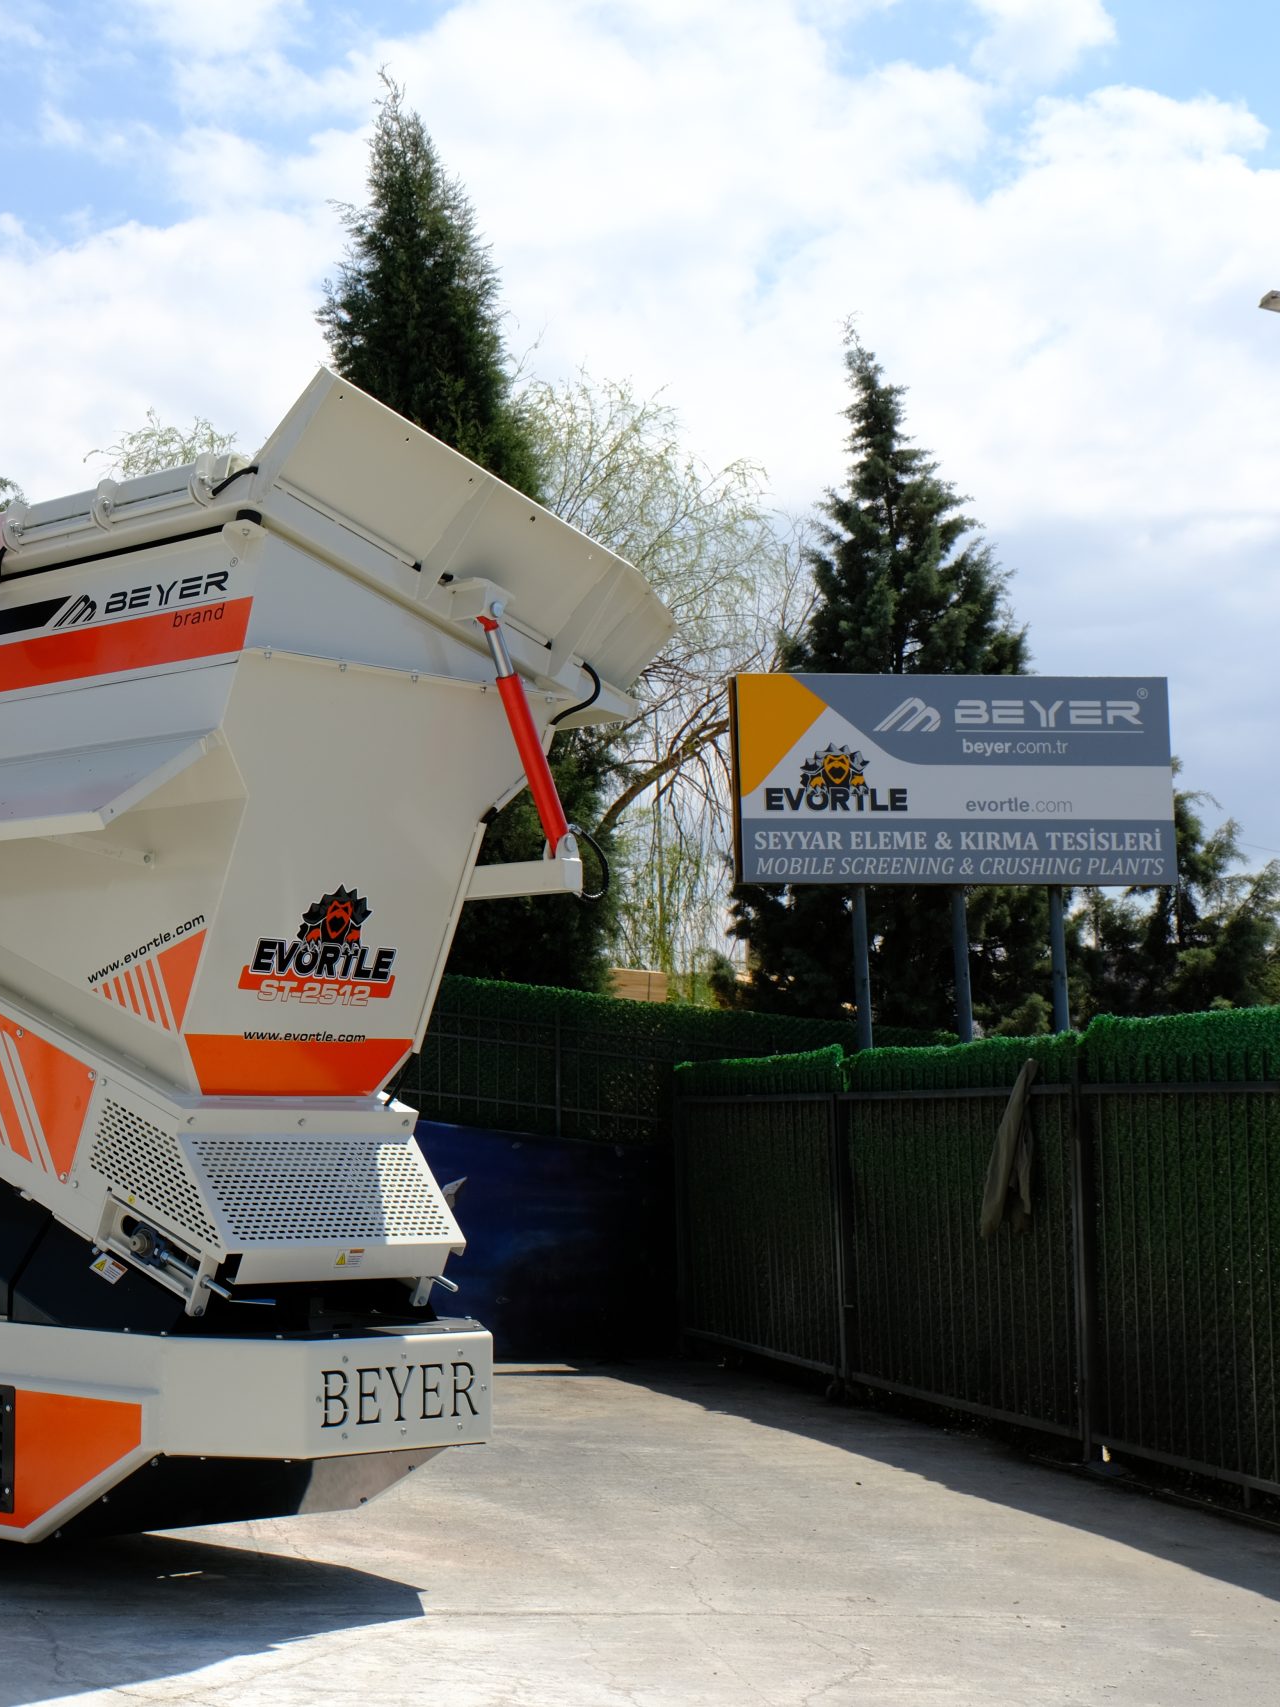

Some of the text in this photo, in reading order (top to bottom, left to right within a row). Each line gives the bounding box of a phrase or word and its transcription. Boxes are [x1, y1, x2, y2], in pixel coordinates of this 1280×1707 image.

[104, 570, 229, 614] BEYER
[172, 603, 225, 628] brand
[954, 699, 1144, 728] BEYER
[961, 738, 1069, 756] beyer.com.tr
[764, 786, 909, 812] EVORTLE
[965, 796, 1073, 814] evortle.com
[754, 827, 1162, 852] SEYYAR ELEME & KIRMA TESİSLERİ
[755, 856, 1165, 876] MOBILE SCREENING & CRUSHING PLANTS
[87, 912, 206, 985] www.evortle.com
[250, 937, 397, 983] EVORTLE
[257, 979, 372, 1007] ST-2512
[243, 1028, 366, 1044] www.evortle.com
[320, 1361, 479, 1429] BEYER
